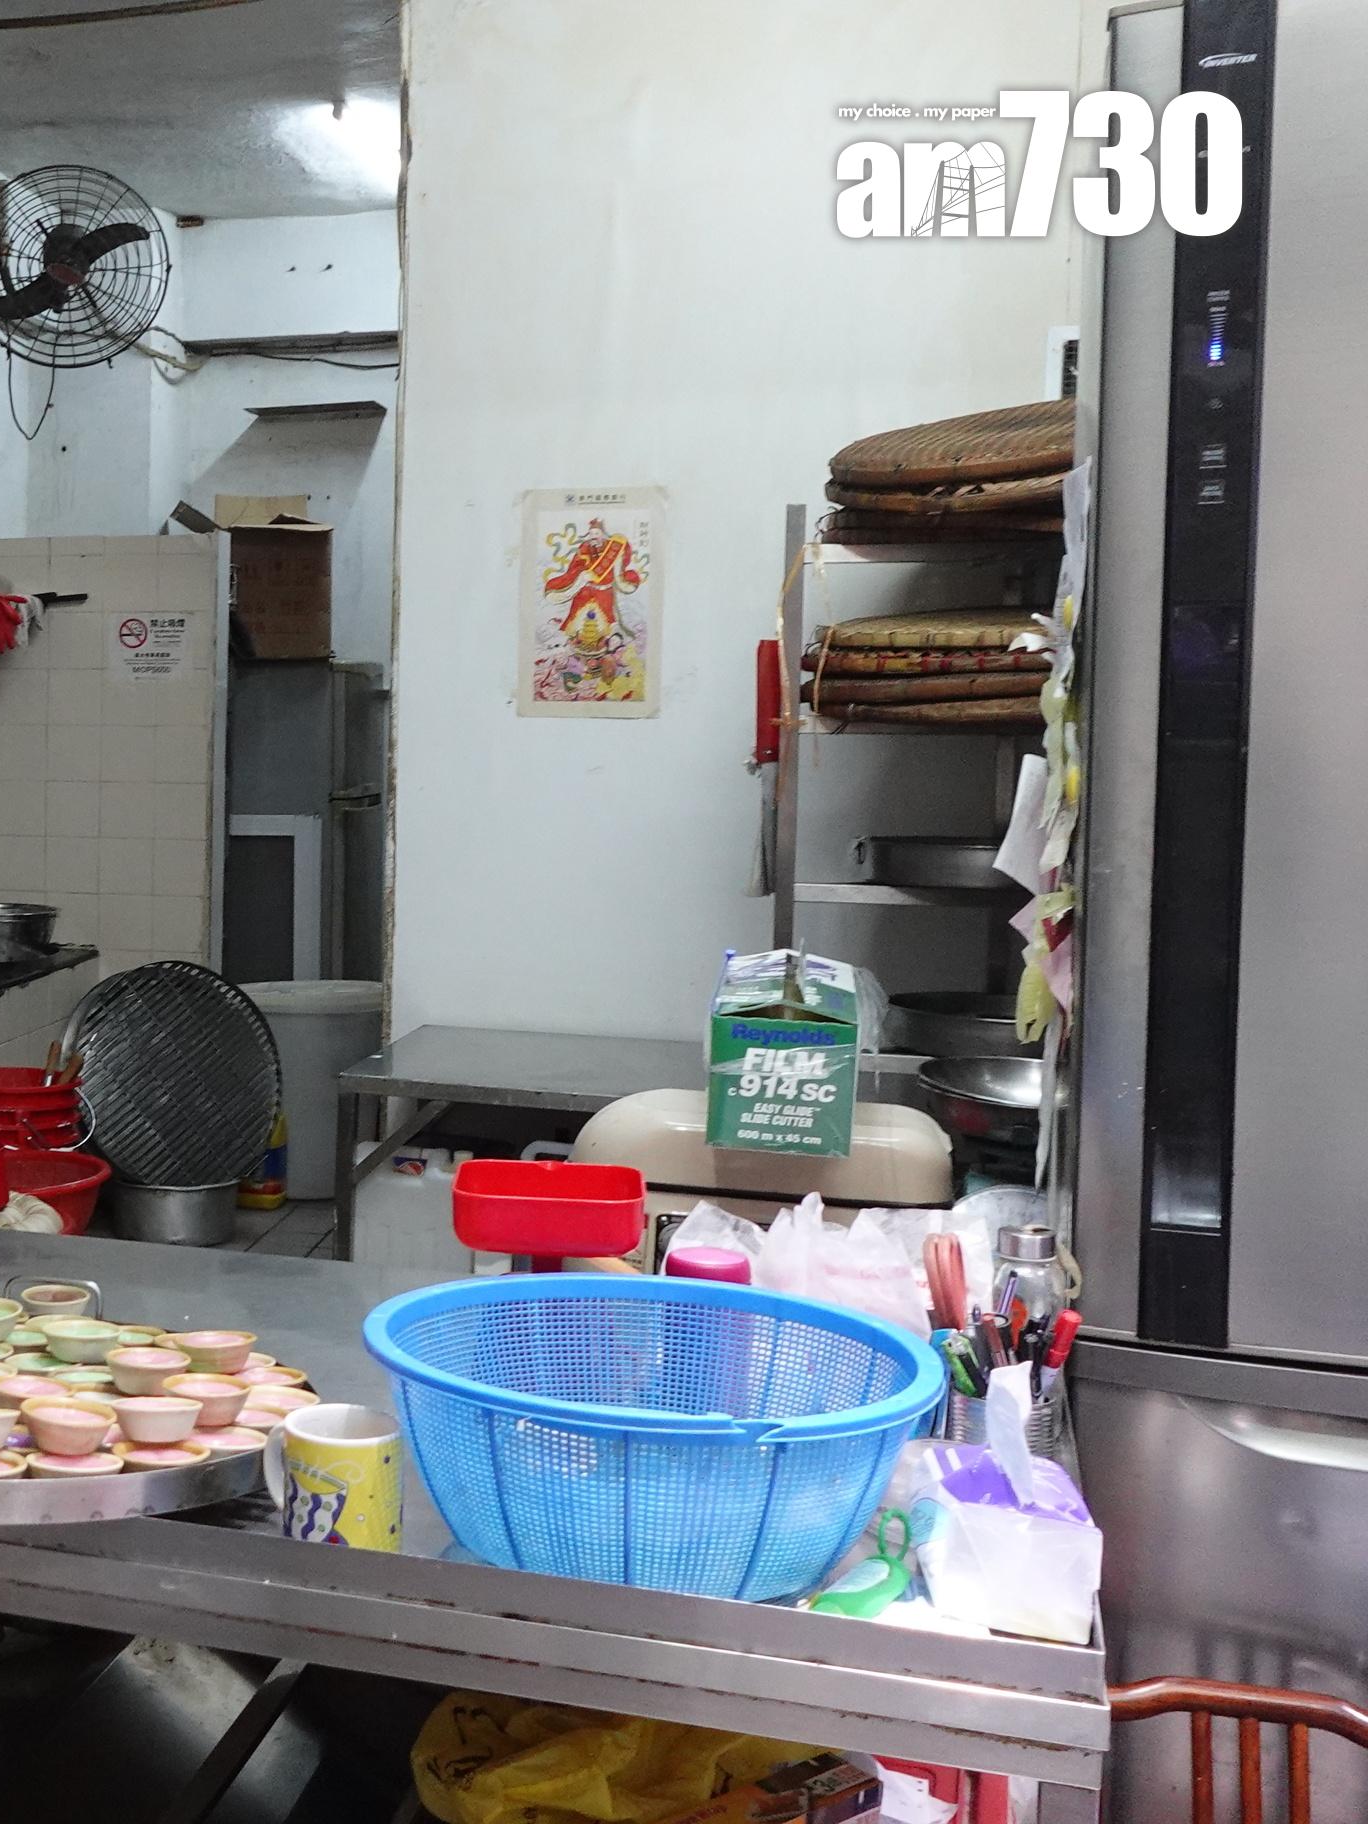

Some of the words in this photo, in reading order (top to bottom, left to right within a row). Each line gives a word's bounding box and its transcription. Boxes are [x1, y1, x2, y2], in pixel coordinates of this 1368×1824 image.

[732, 1023, 836, 1046] Reynolds
[742, 1047, 827, 1076] FILM
[800, 1082, 838, 1103] SC
[753, 1103, 782, 1114] EASY
[740, 1112, 771, 1125] SLIDE
[771, 1115, 814, 1128] CUTTER
[737, 1129, 760, 1140] 600
[761, 1132, 773, 1141] m
[802, 1136, 823, 1145] cm
